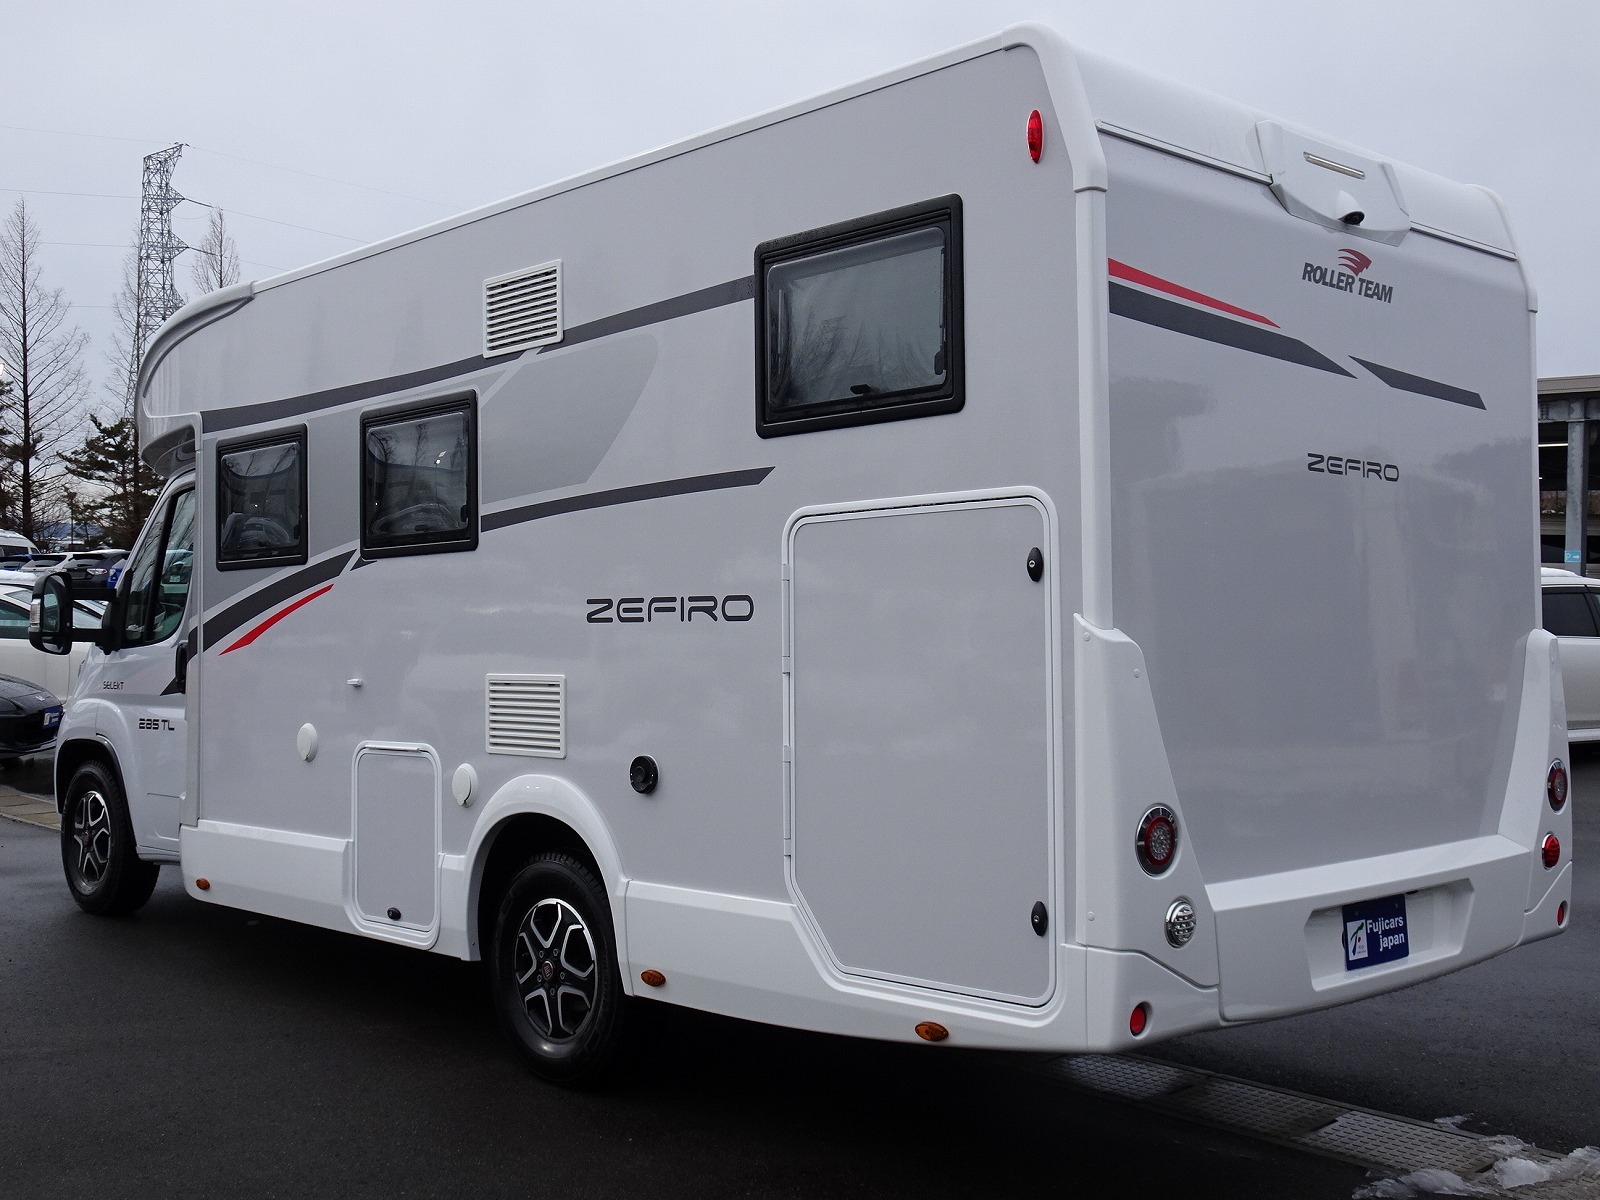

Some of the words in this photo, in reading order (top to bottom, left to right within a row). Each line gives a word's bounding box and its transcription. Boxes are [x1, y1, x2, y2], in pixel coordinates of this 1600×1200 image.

[1302, 262, 1355, 293] ROLLER
[1358, 277, 1394, 304] TEAM
[1307, 452, 1400, 482] ZEFIRO
[586, 594, 754, 623] ZEFIRO
[161, 719, 175, 731] TL
[1366, 916, 1404, 935] Fujicars
[1379, 932, 1405, 952] japan
